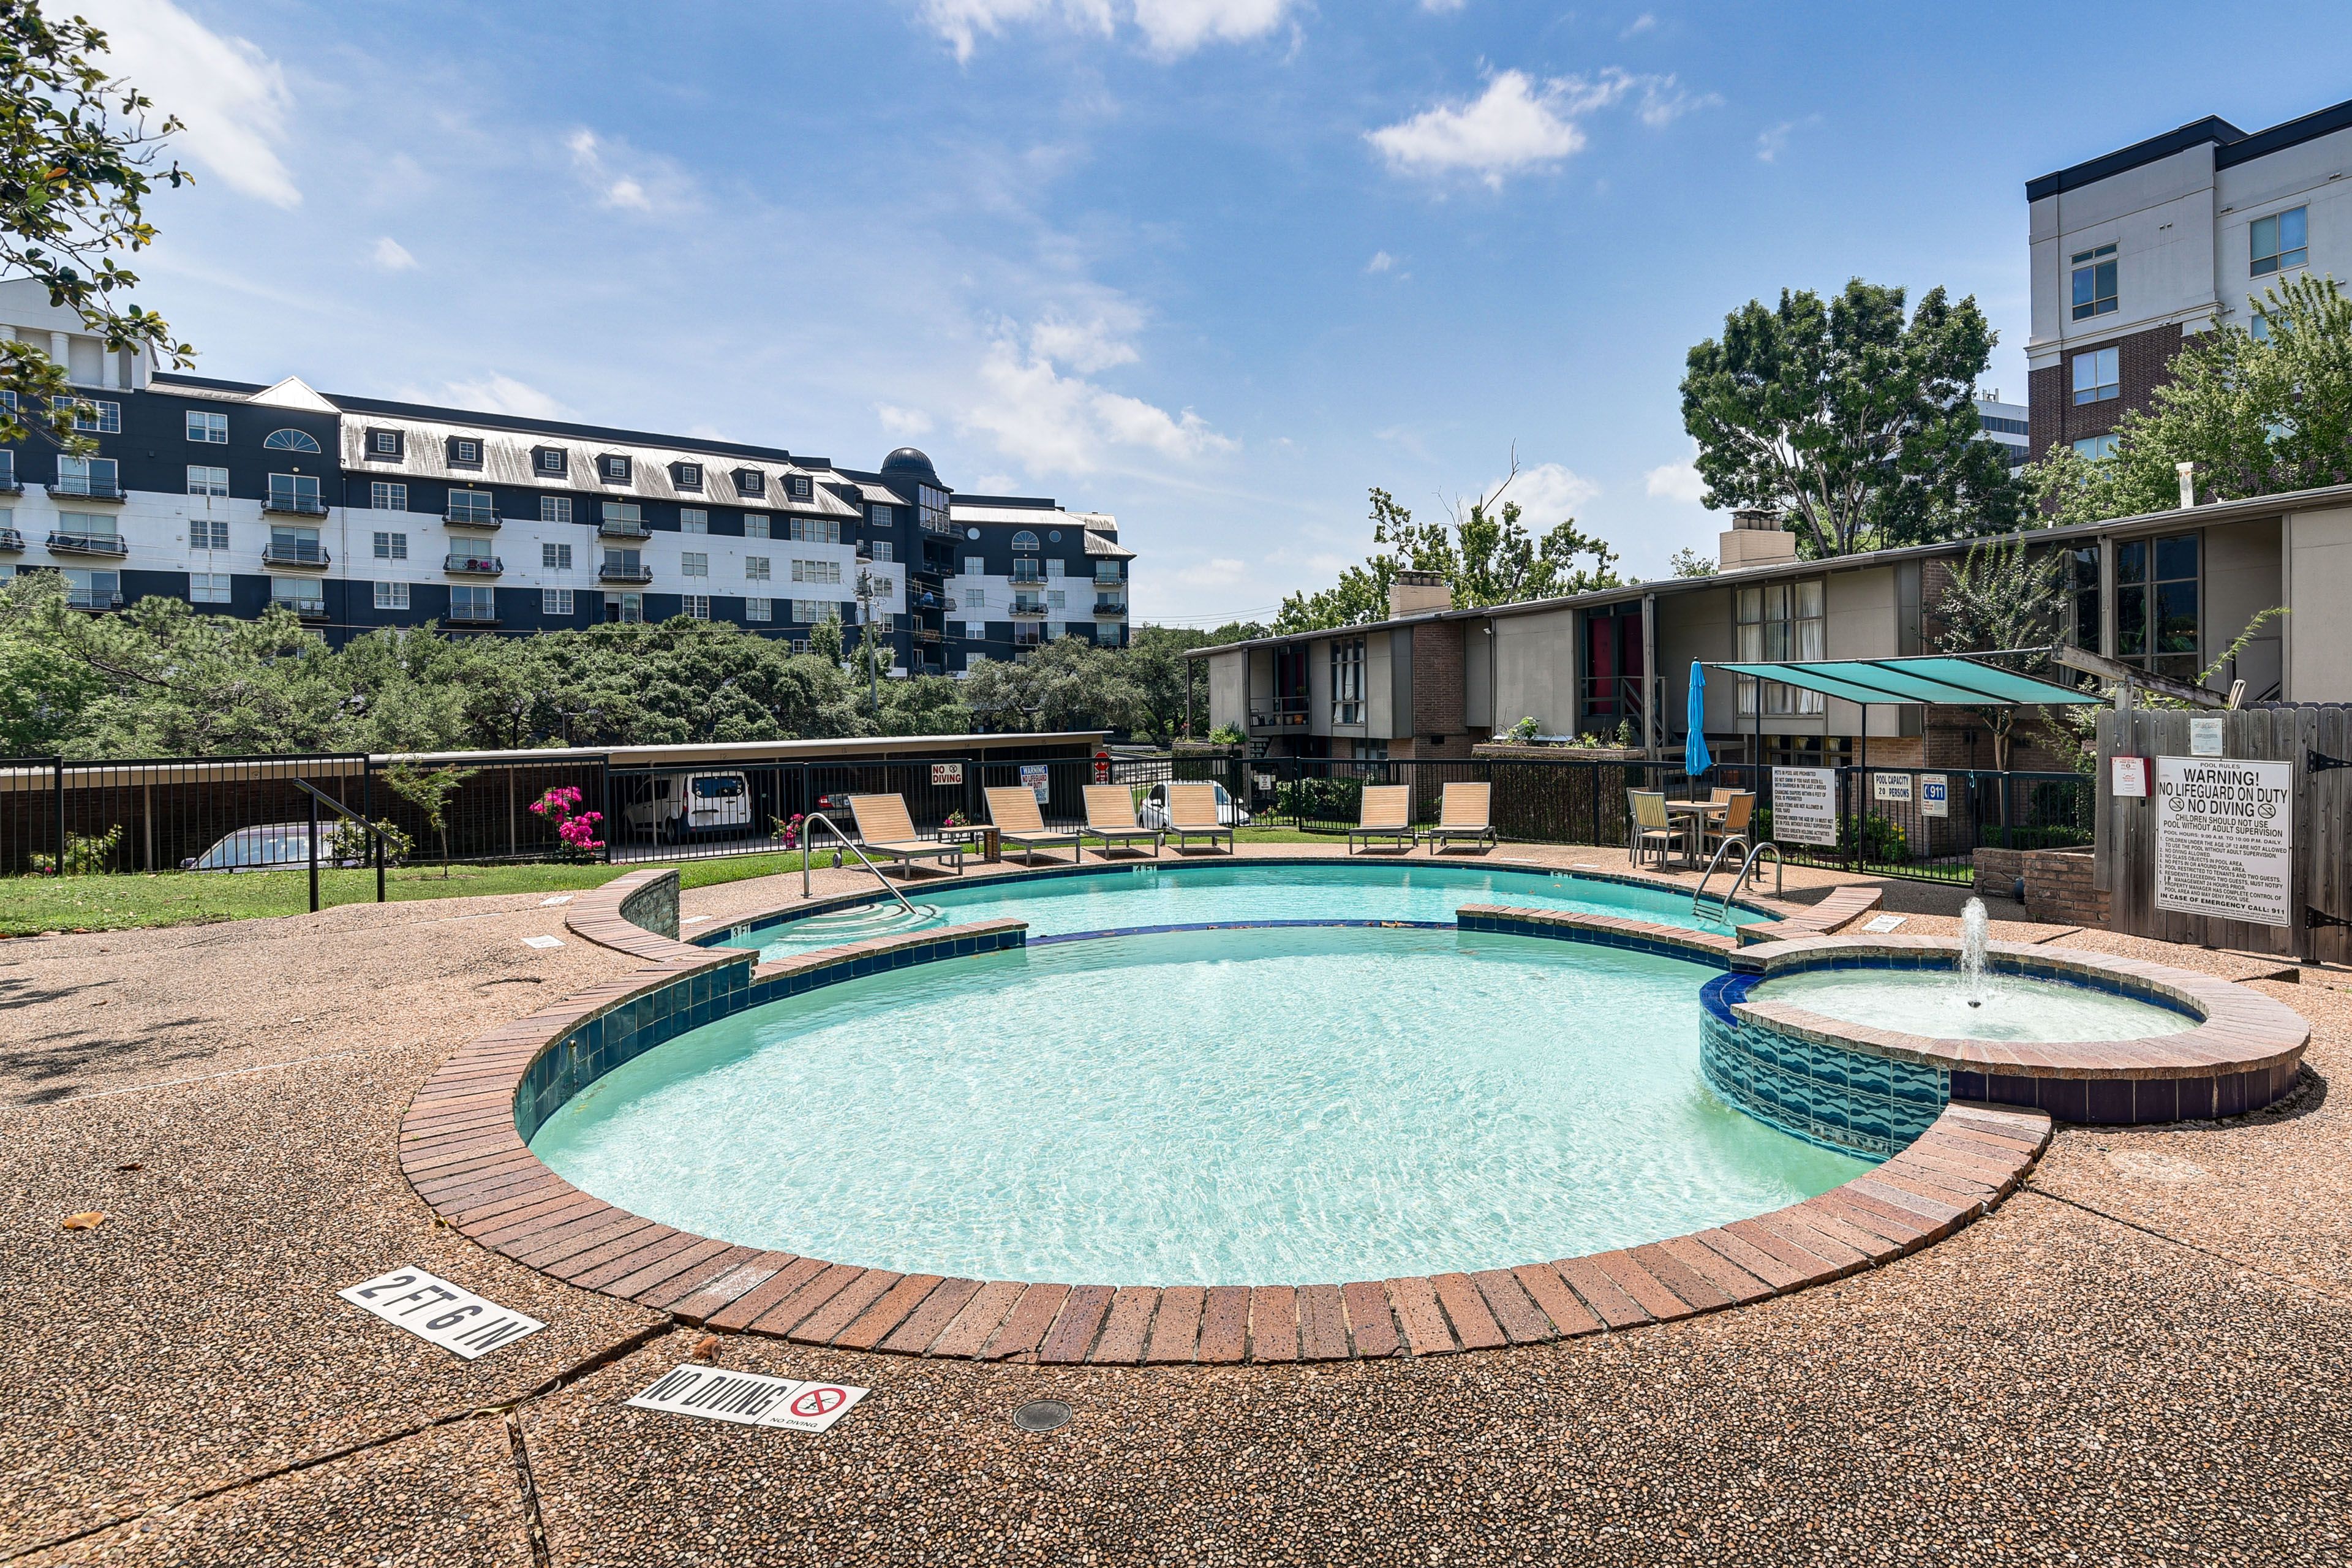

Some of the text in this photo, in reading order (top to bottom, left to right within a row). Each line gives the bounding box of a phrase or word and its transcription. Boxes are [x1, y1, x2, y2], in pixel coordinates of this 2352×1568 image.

[933, 774, 961, 783] DIVING
[1876, 775, 1909, 785] POOL CAPACITY
[2184, 768, 2258, 786] WARNING!
[1889, 788, 1909, 797] PERSONS
[1931, 785, 1943, 798] 911
[2159, 782, 2287, 804] NO LIFEGUARD ON DUTY
[2188, 798, 2254, 817] NO DIVING
[2176, 813, 2268, 828] CHILDREN SHOULD NOT USE
[2163, 820, 2282, 837] POOL WITHOUT ADULT SUPERVISION
[2174, 876, 2205, 885] MANAGEMENT
[2223, 888, 2248, 897] COMPLETE
[2201, 898, 2245, 909] EMERGENCY
[2247, 904, 2269, 913] CALL:
[733, 923, 749, 937] 3 FT
[356, 1275, 529, 1351] 2 FT 6 IN
[639, 1370, 788, 1416] NO DIVING
